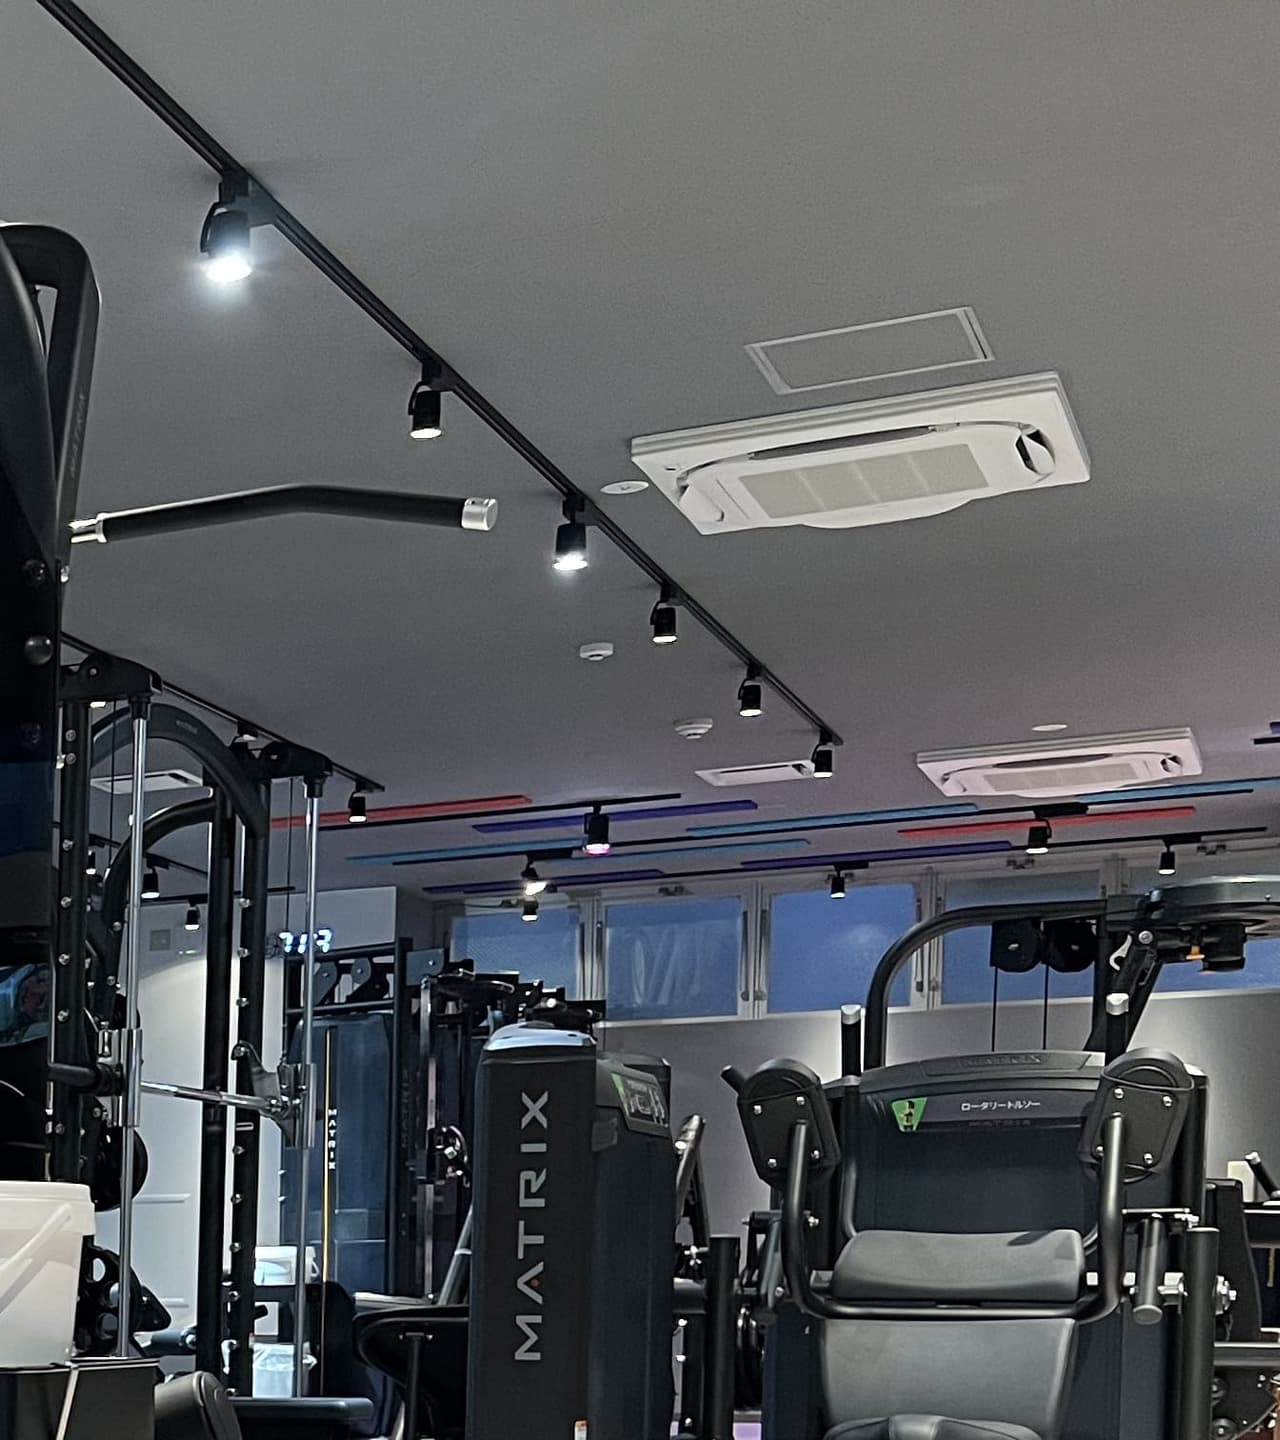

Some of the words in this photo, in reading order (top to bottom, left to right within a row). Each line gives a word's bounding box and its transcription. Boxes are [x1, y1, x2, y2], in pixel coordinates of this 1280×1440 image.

[961, 1101, 1041, 1111] ロータリートルソー
[328, 1109, 337, 1169] MATRIX
[514, 1090, 549, 1361] MATRIX
